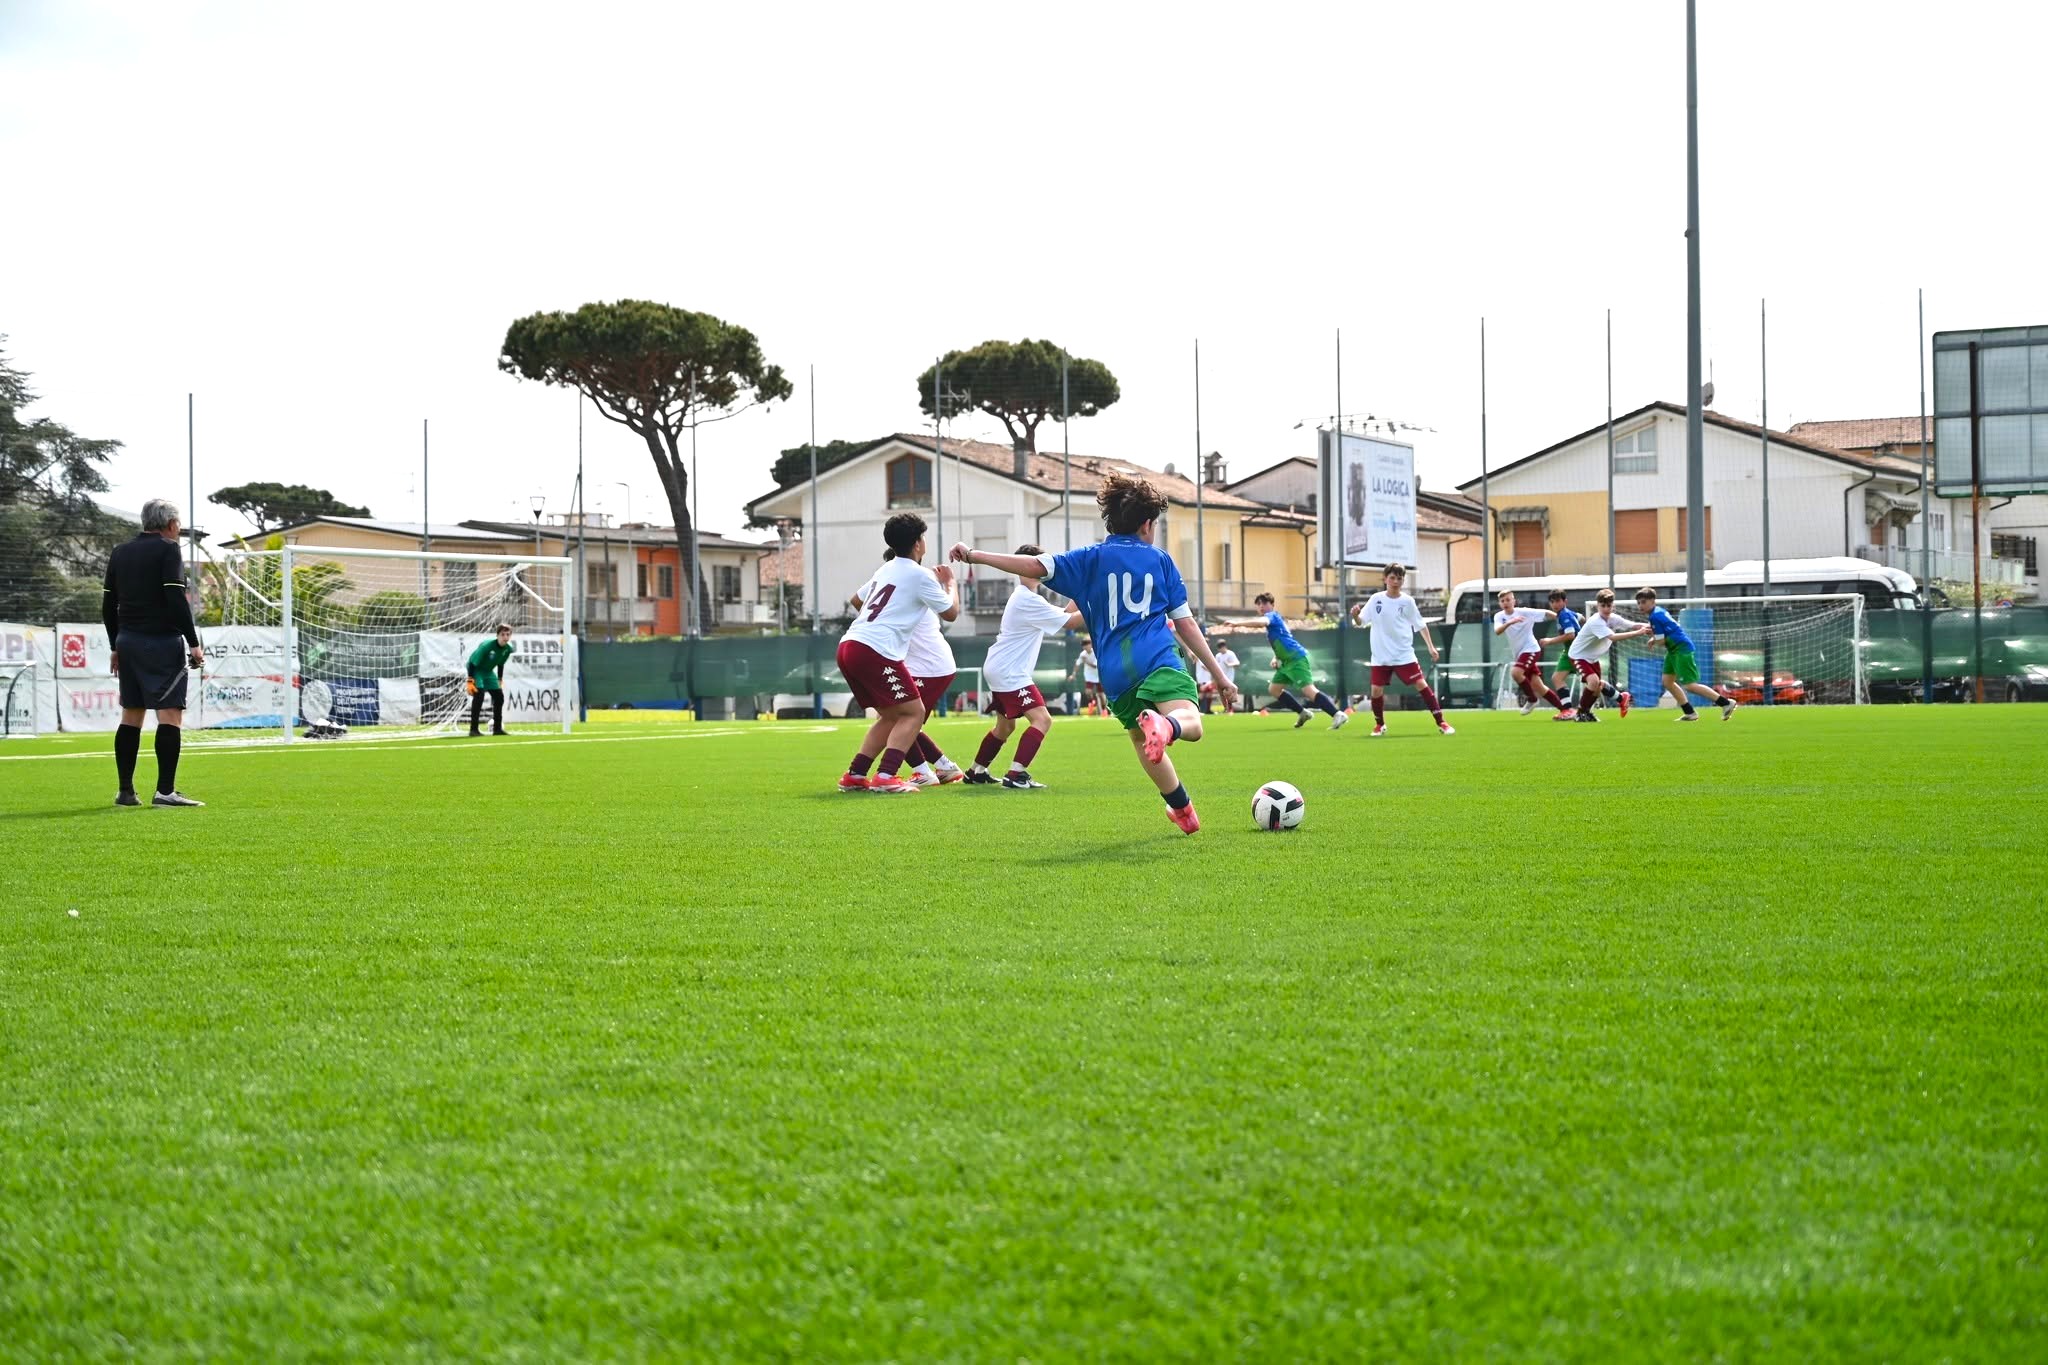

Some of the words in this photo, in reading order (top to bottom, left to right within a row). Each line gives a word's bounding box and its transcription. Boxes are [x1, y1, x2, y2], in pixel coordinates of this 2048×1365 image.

[1372, 478, 1381, 493] LA
[1383, 479, 1410, 497] LOGICA
[1107, 572, 1154, 631] 14
